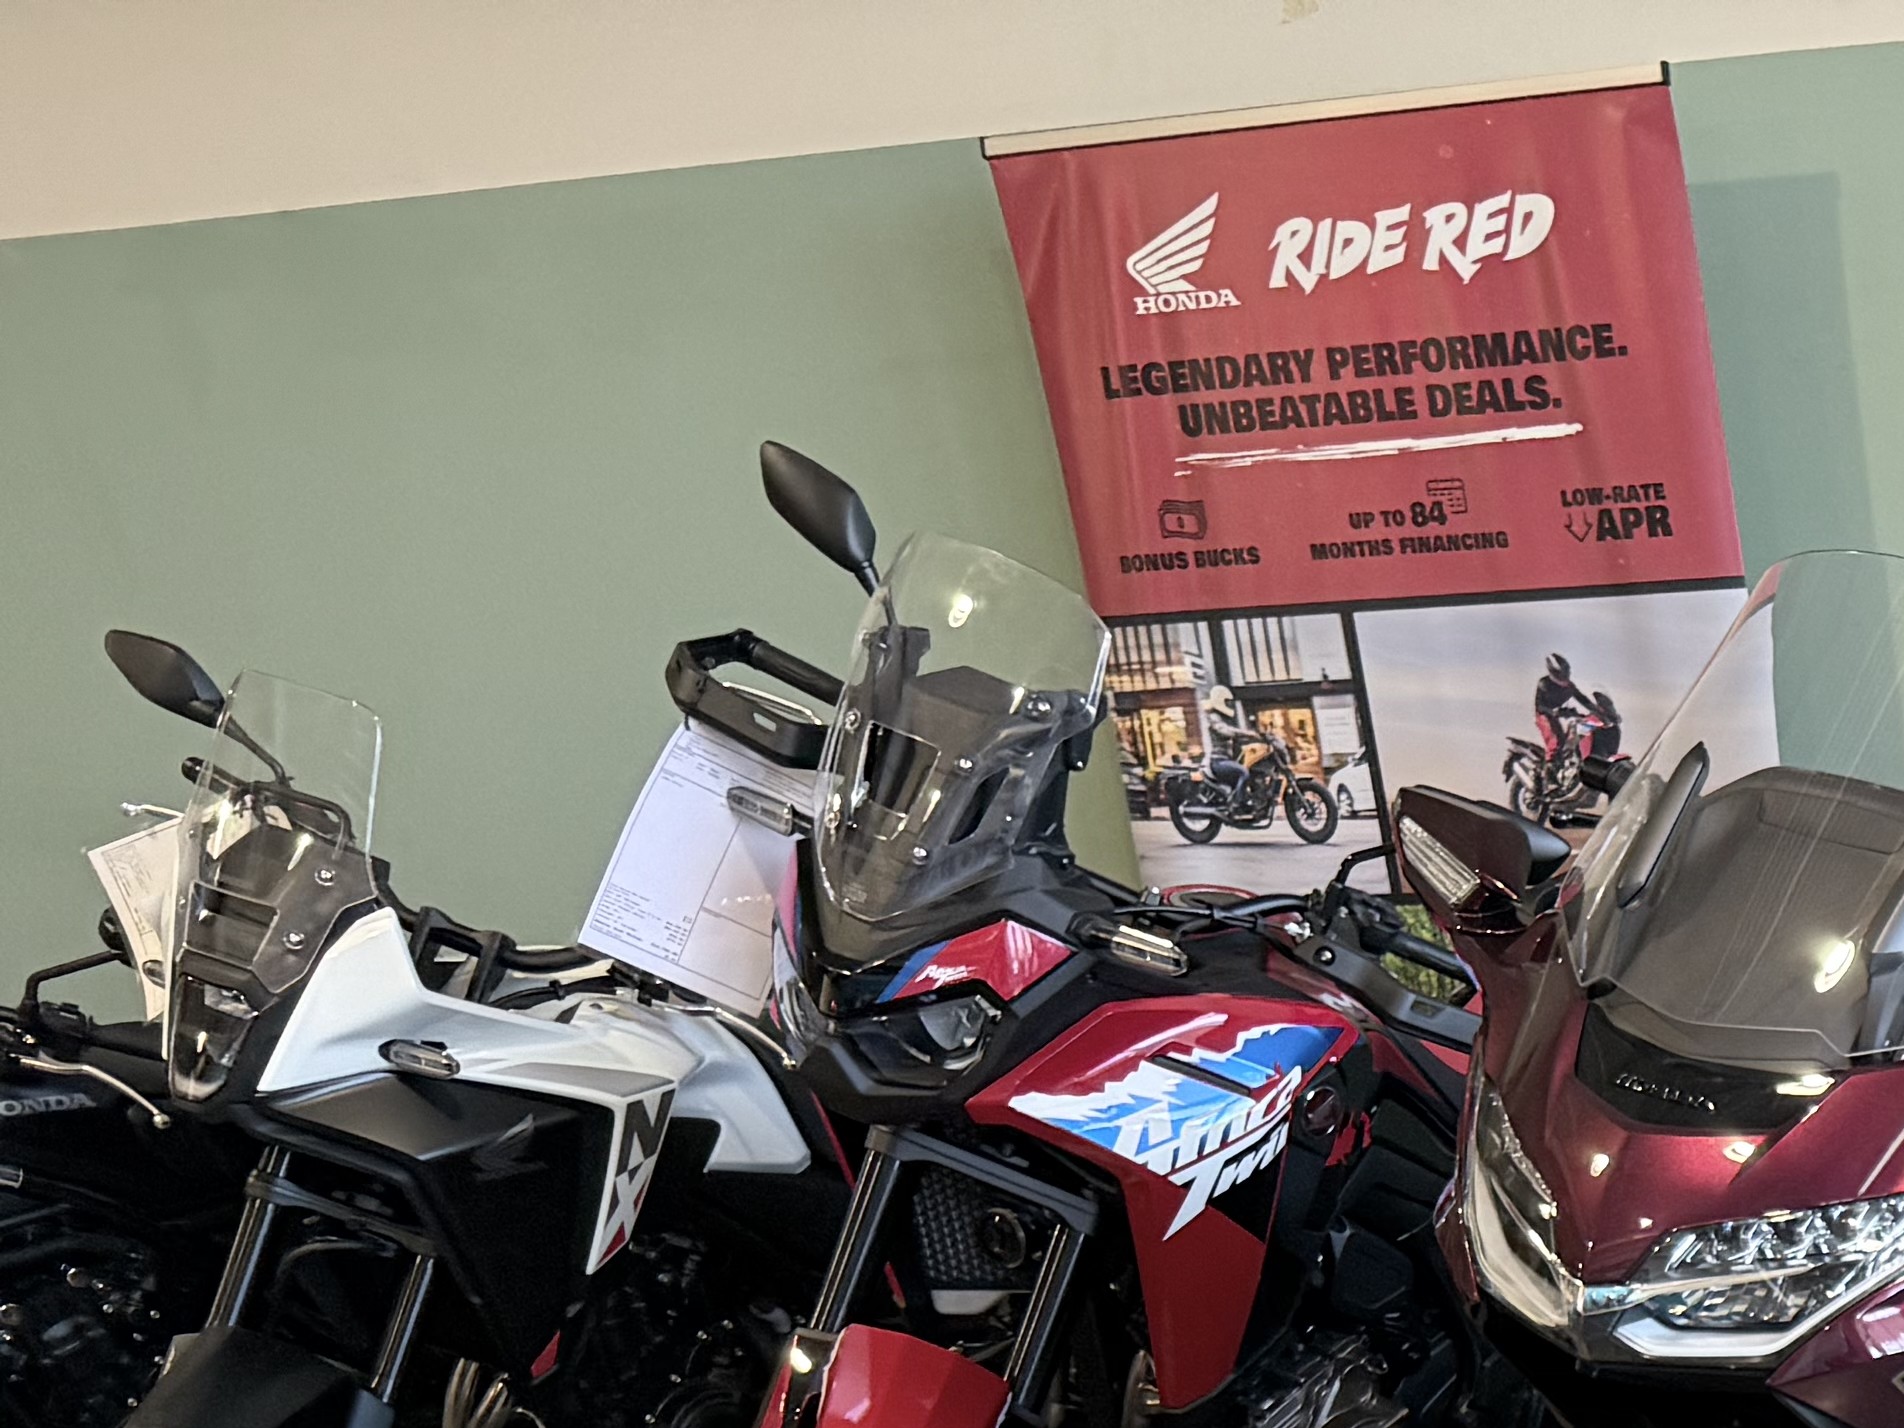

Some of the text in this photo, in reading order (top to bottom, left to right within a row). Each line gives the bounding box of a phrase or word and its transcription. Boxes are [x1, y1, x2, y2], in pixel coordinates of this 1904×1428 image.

[1268, 189, 1555, 294] RIDE RED
[1134, 288, 1241, 316] HONDA
[1099, 322, 1628, 400] LEGENDARY PERFORMANCE.
[1178, 374, 1563, 438] UNBEATABLE DEALS.
[1560, 482, 1666, 509] LOW-RATE
[1348, 501, 1447, 530] UP TO 84
[1596, 504, 1673, 542] APR
[1119, 544, 1261, 574] BONUS BUCKS
[1309, 529, 1510, 562] MONTHS FINANCING
[0, 1092, 97, 1117] ONDA
